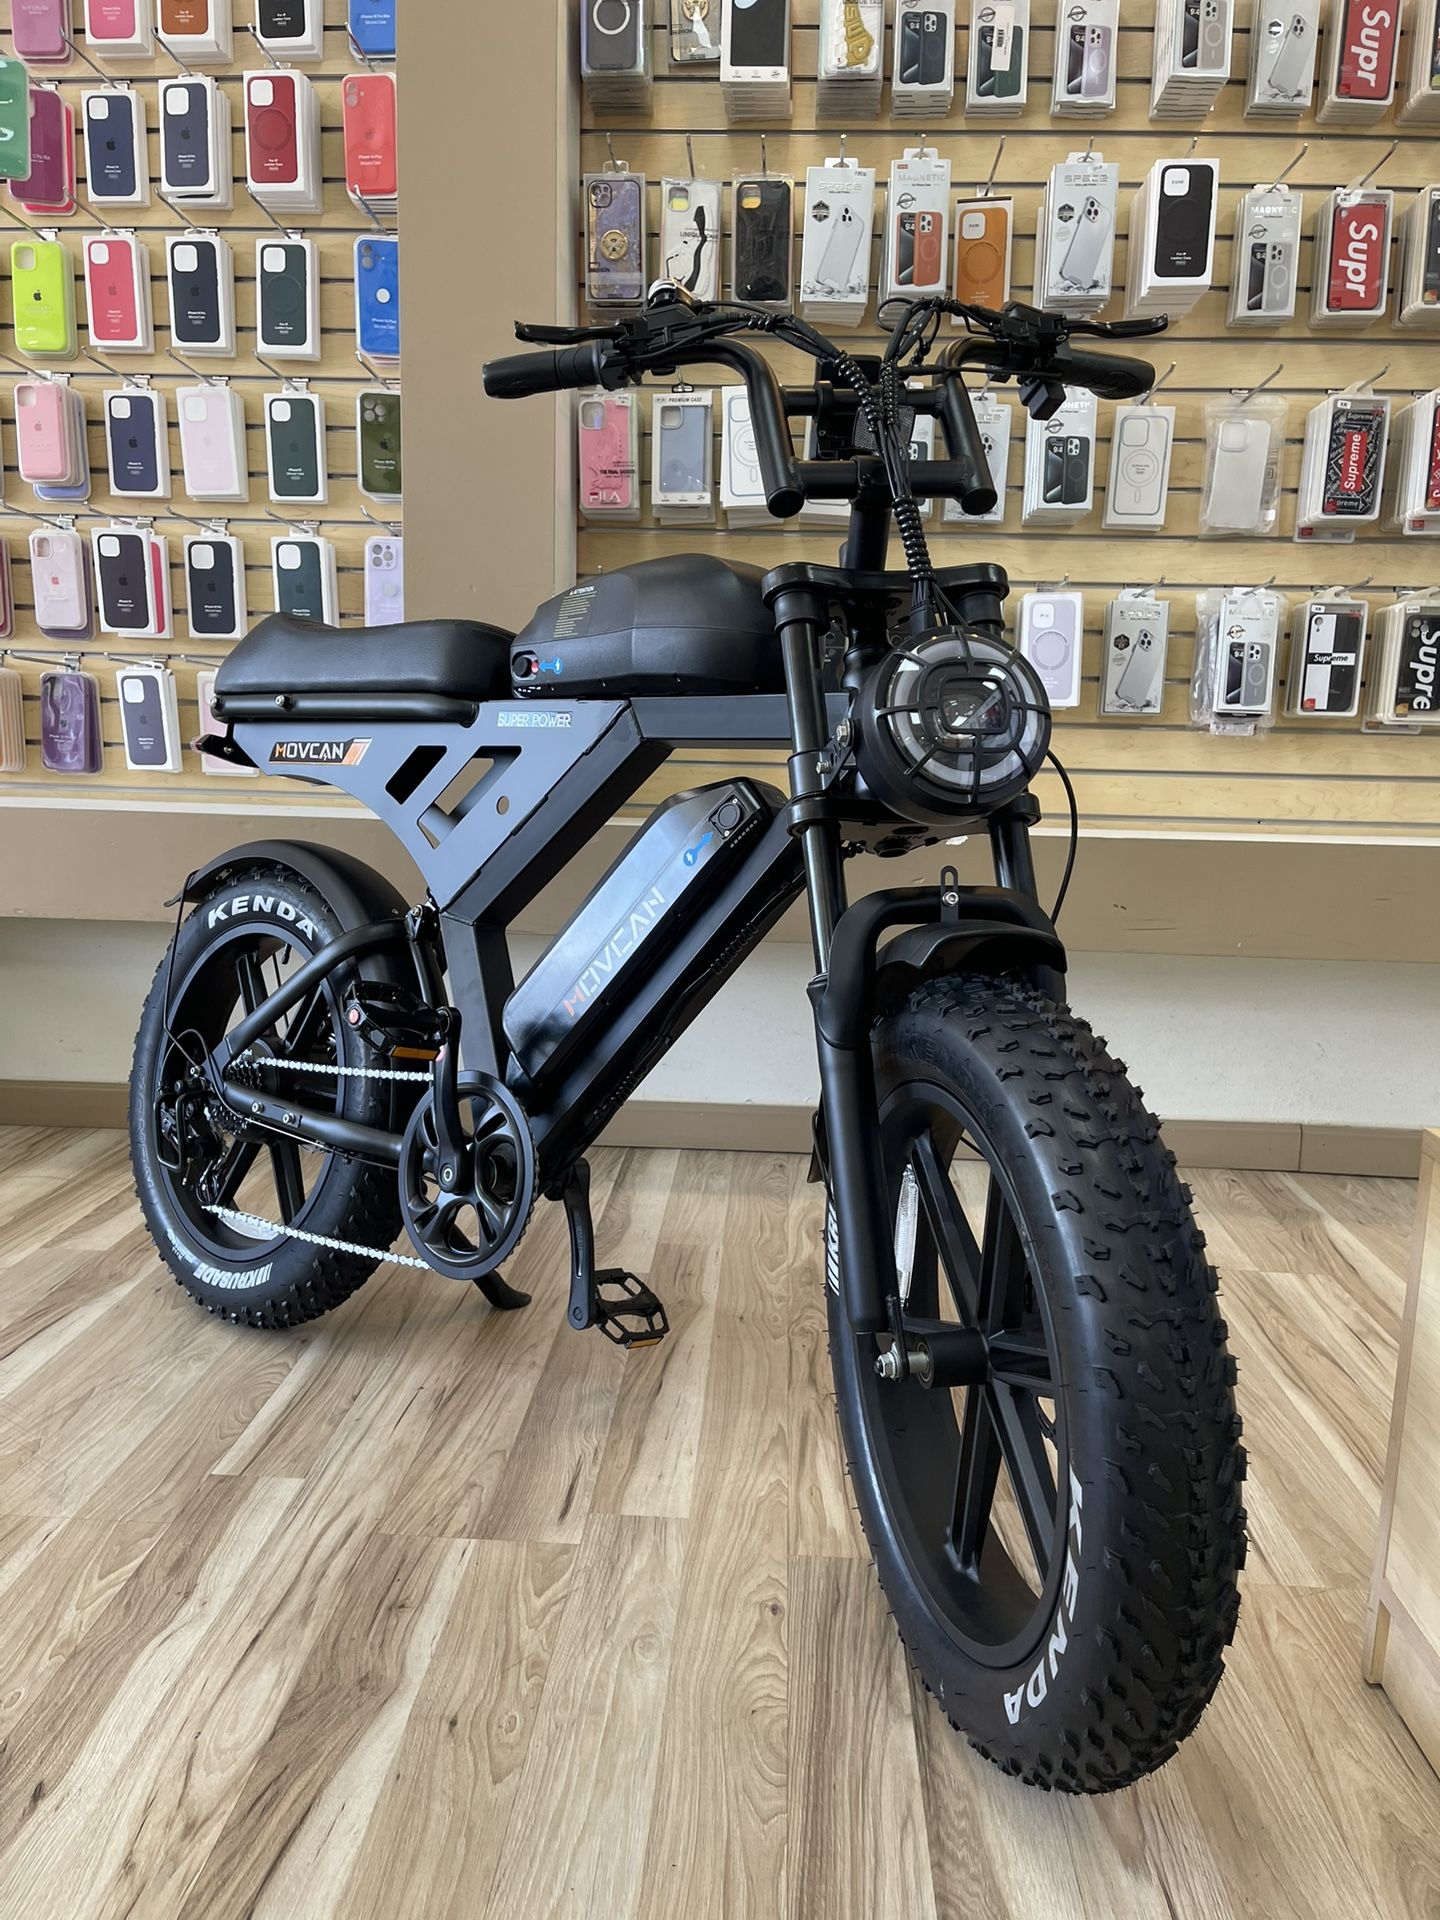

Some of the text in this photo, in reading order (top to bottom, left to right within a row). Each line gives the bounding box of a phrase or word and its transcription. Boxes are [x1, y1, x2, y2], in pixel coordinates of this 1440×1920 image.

[1350, 6, 1391, 87] Supr
[1338, 220, 1379, 298] Supr
[1344, 433, 1362, 490] Supreme
[589, 491, 622, 503] FILA
[1313, 653, 1349, 664] Supreme
[498, 712, 571, 727] SUPER POWER
[275, 741, 344, 760] MOVCAN
[208, 895, 318, 941] KENDA
[562, 886, 667, 1017] MOVCAN
[1003, 1462, 1083, 1726] KENDA
